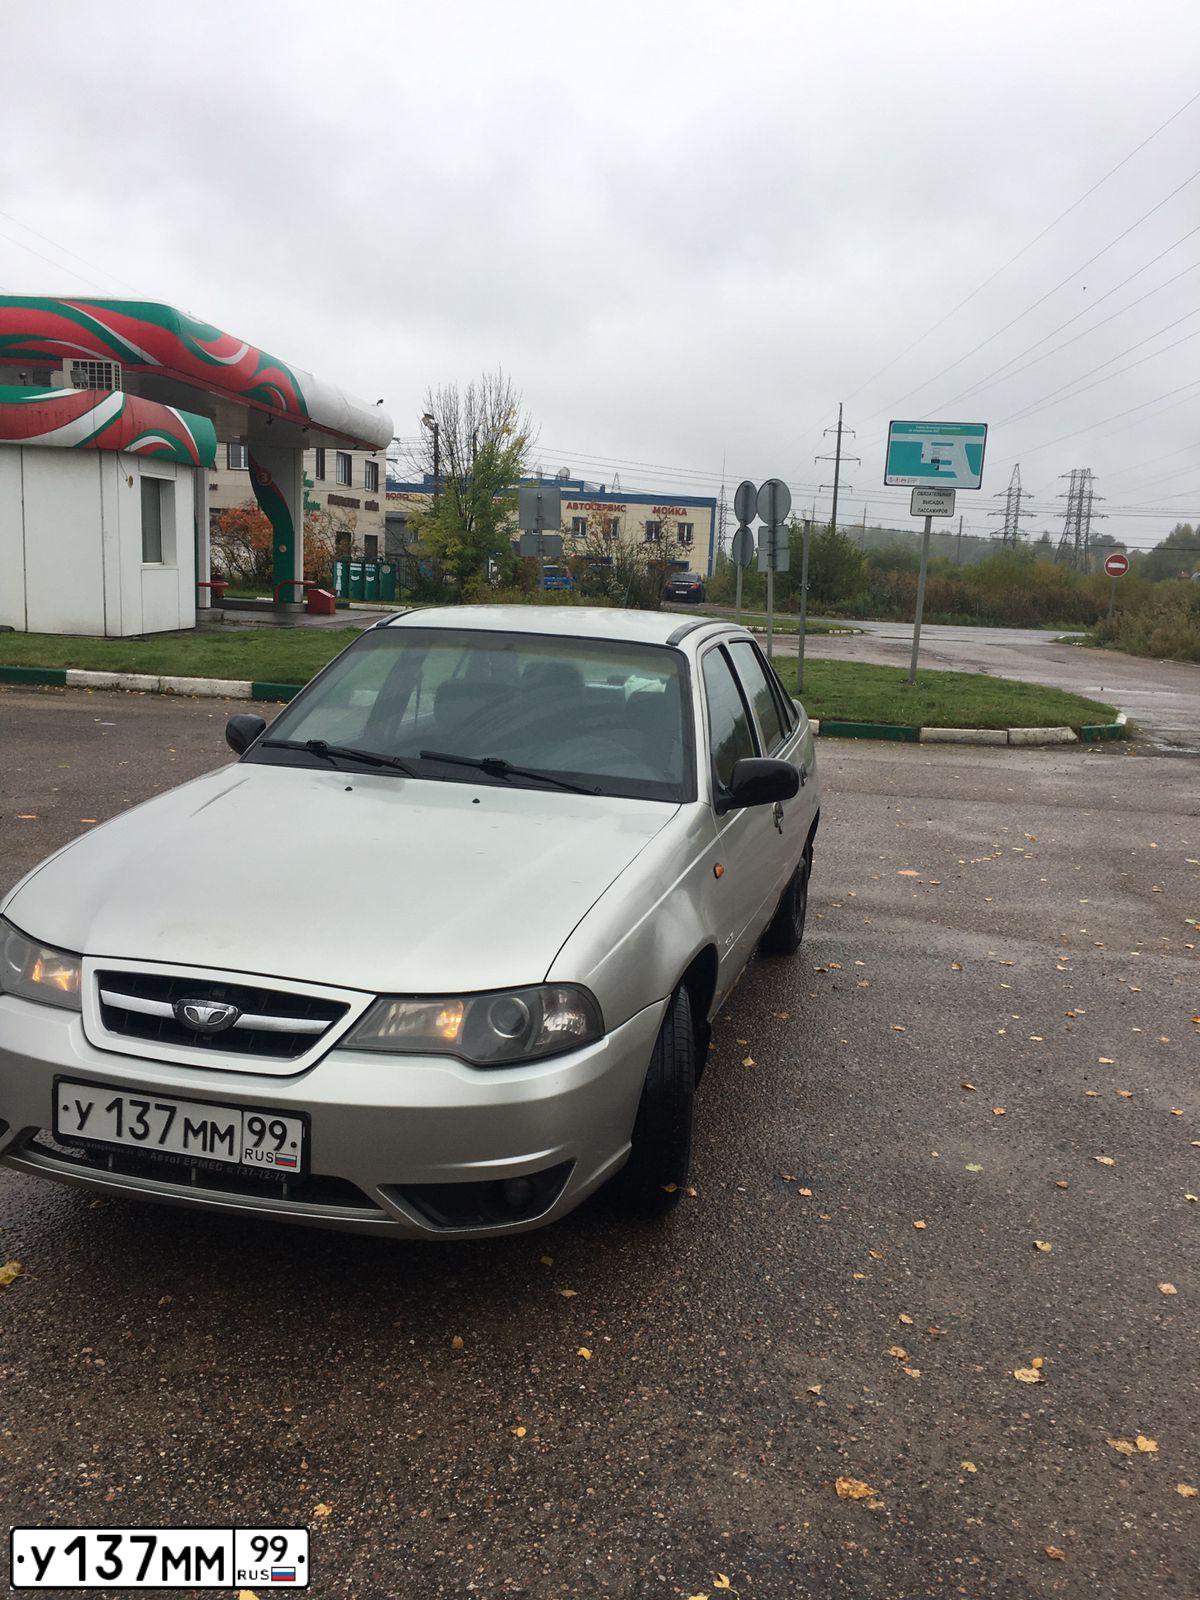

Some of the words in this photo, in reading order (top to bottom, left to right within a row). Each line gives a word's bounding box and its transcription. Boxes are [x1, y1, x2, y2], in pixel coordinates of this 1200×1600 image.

[566, 502, 627, 513] АВТОСЕРВИС
[652, 505, 688, 516] МОЙКА
[247, 1116, 288, 1151] 99
[244, 1148, 274, 1164] RUS
